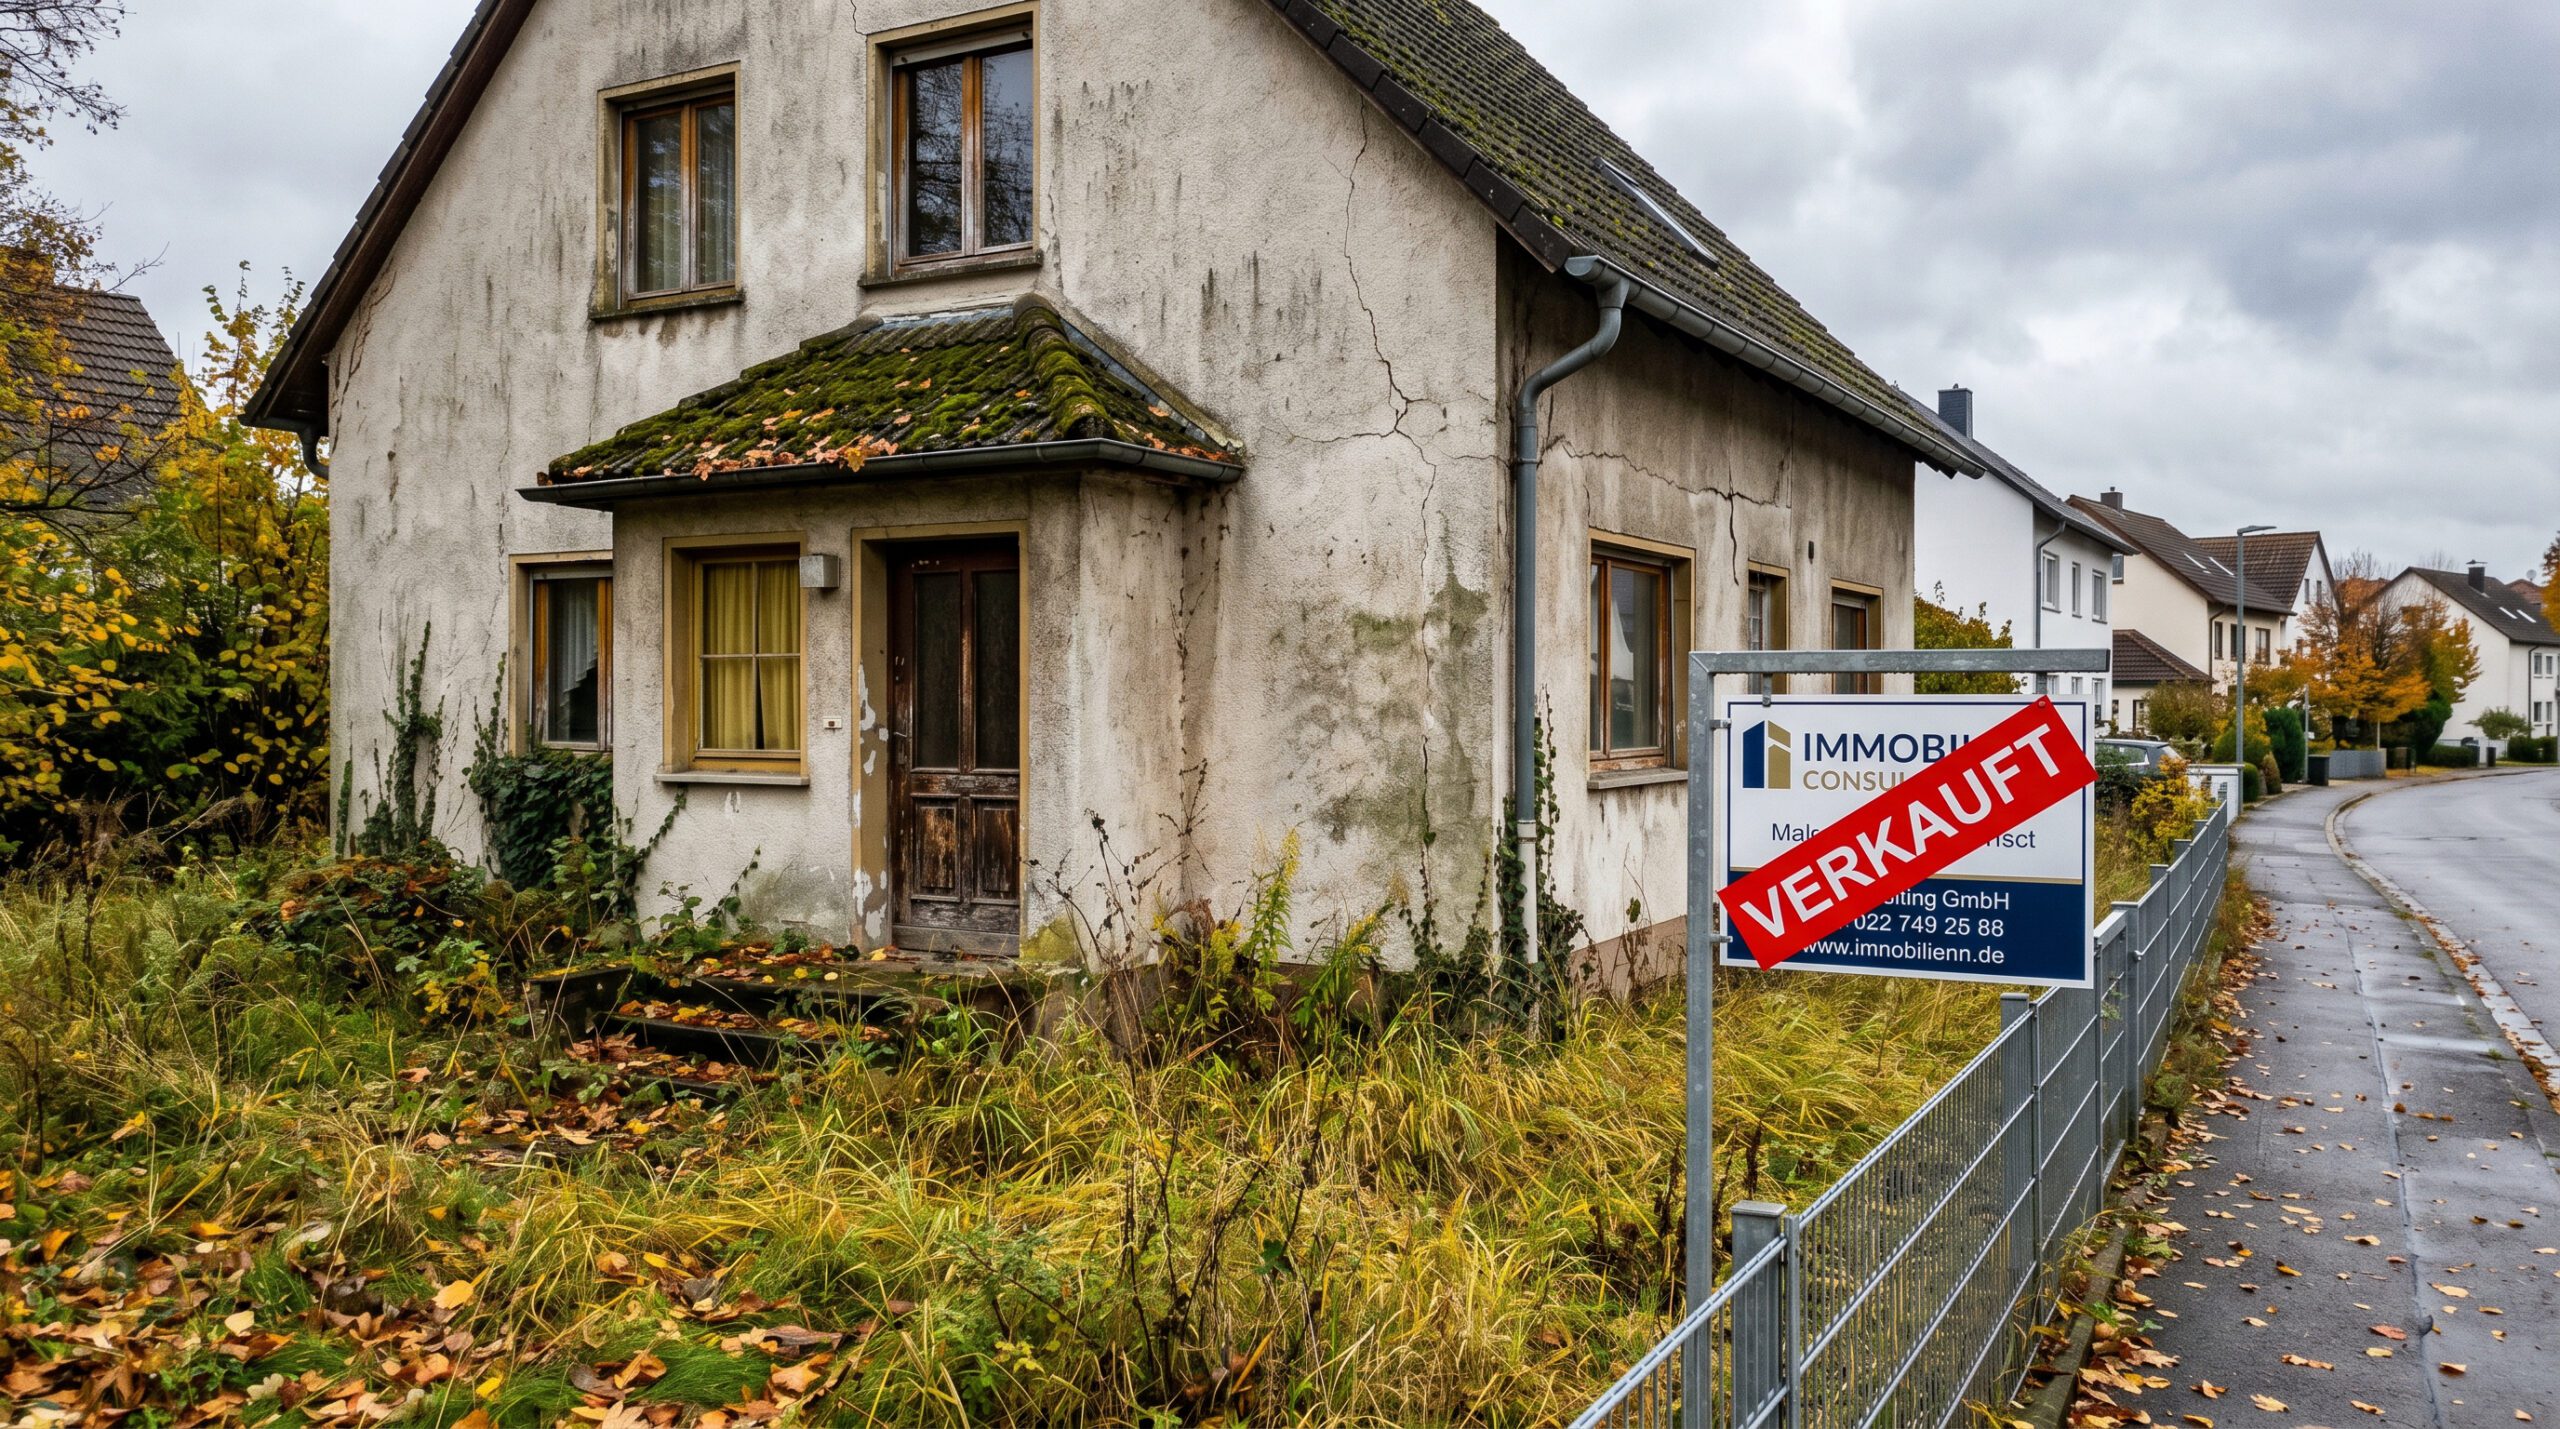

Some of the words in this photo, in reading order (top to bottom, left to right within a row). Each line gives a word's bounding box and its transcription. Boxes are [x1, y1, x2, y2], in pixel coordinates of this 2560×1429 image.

[1739, 723, 2061, 938] VERKAUFT
[1942, 889, 2009, 910] GmbH
[1854, 913, 1892, 931] 022
[1898, 914, 1937, 933] 749
[1944, 917, 1970, 935] 25
[1978, 918, 2004, 937] 88
